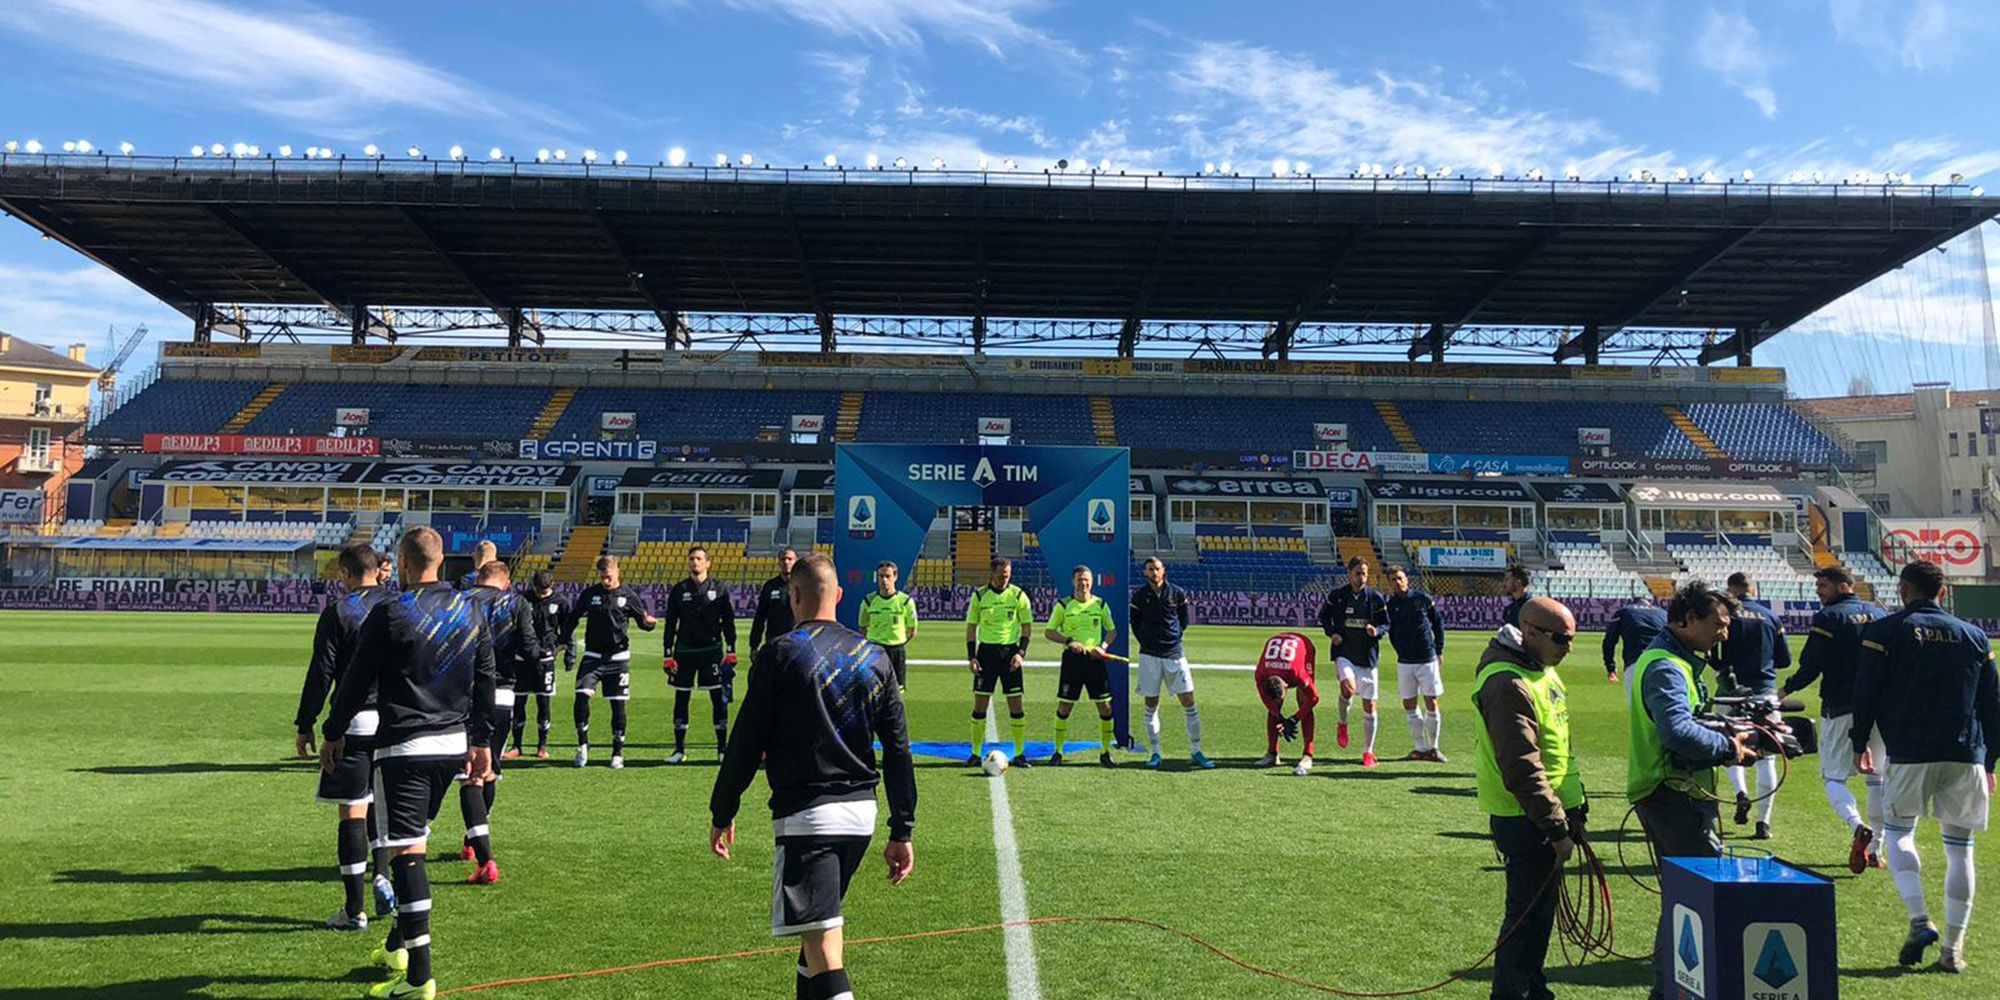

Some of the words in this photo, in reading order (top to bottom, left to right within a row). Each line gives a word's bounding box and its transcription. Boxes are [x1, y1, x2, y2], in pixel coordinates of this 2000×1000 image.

[468, 351, 550, 362] PETITOT
[1200, 360, 1242, 373] PARMA
[1244, 360, 1276, 373] CLUB
[544, 441, 633, 457] GRENTI
[231, 461, 352, 473] CANOVI
[1308, 452, 1372, 469] DECA
[1654, 462, 1683, 472] Centro
[1685, 463, 1711, 472] Ottico
[162, 471, 342, 483] COPERTURE
[446, 464, 566, 477] CANOVI
[908, 463, 966, 482] SERIE
[1003, 464, 1039, 482] TIM
[381, 474, 560, 487] COPERTURE
[1410, 485, 1523, 498] ilger.com
[1668, 490, 1781, 502] ilger.com
[0, 491, 41, 510] Fer
[104, 591, 210, 604] RAMPULLA
[217, 593, 319, 606] RAMPULLA
[1195, 606, 1299, 619] RAMPULLA
